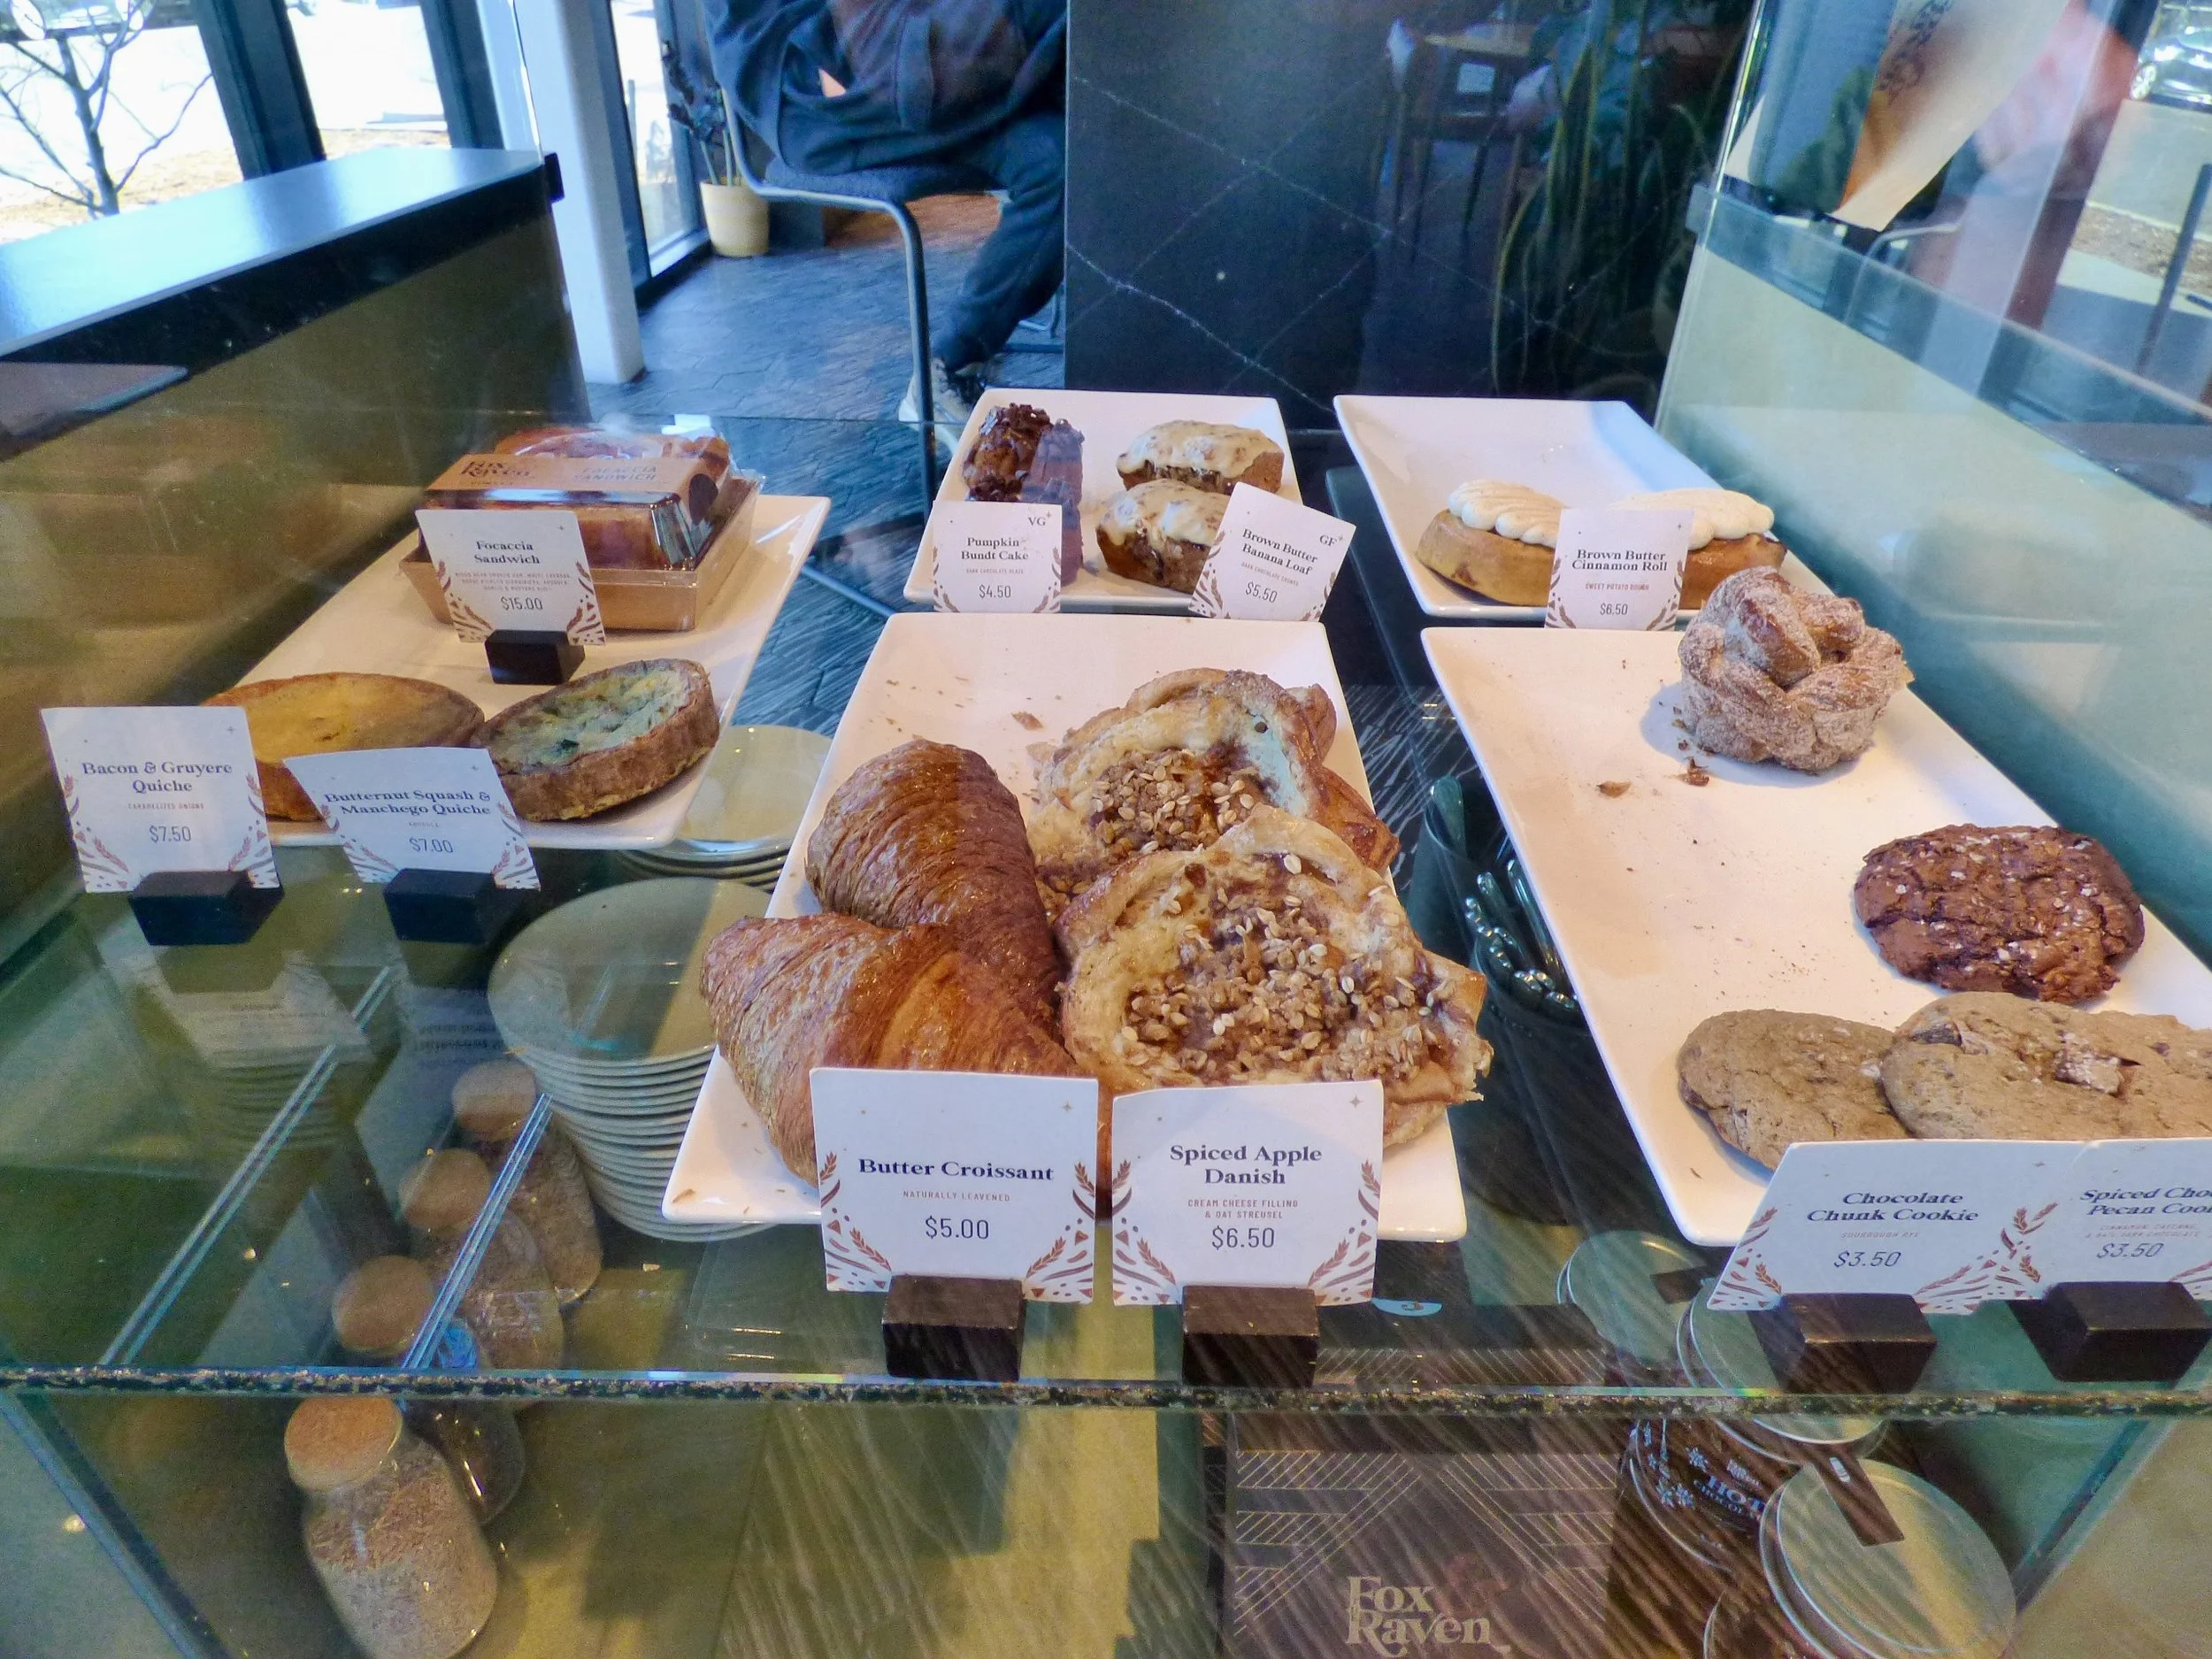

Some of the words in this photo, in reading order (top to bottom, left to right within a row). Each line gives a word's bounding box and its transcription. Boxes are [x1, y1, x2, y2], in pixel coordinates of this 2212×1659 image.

[1028, 517, 1046, 526] VG
[476, 541, 534, 550] Focaccia
[967, 537, 1019, 549] Pumpkin
[1242, 528, 1281, 550] Brown
[1283, 541, 1318, 564] Butter
[1319, 534, 1338, 547] GF
[474, 554, 541, 565] Sandwich
[961, 550, 996, 560] Bundt
[999, 550, 1029, 560] Cake
[1242, 543, 1283, 566] Banana
[1286, 558, 1314, 576] Loaf
[1577, 549, 1621, 560] Brown
[1625, 550, 1666, 561] Butter
[1572, 559, 1639, 571] Cinnamon
[1642, 562, 1668, 572] Roll
[979, 584, 1011, 599] $4.50
[1245, 581, 1278, 603] $5.50
[500, 596, 543, 611] $15.00
[1600, 603, 1628, 616] $6.50
[82, 762, 139, 774] Bacon
[143, 762, 157, 774] &
[161, 762, 233, 778] Gruyere
[133, 780, 193, 794] Quiche
[324, 791, 410, 803] Butternut
[413, 790, 474, 803] Squash
[479, 792, 491, 802] &
[340, 804, 429, 816] Manchego
[433, 803, 491, 815] Quiche
[149, 825, 192, 843] $7.50
[409, 837, 454, 854] $7.00
[1170, 1144, 1248, 1166] Spiced
[1254, 1146, 1323, 1166] Apple
[858, 1158, 935, 1176] Butter
[941, 1161, 1055, 1180] Croissant
[1204, 1168, 1286, 1185] Danish
[902, 1190, 957, 1201] NATURALLY
[961, 1192, 1010, 1202] LEAVENED
[1842, 1192, 1963, 1204] Chocolate
[2080, 1188, 2162, 1203] Spiced
[2164, 1187, 2212, 1198] Cho
[1187, 1199, 1219, 1208] CREAM
[1222, 1199, 1258, 1208] CHEESE
[2086, 1204, 2155, 1215] Pecan
[1236, 1210, 1283, 1219] STREUSEL
[1807, 1210, 1886, 1221] Chunk
[1893, 1209, 1979, 1221] Cookie
[925, 1215, 989, 1240] $5.00
[1211, 1225, 1275, 1250] $6.50
[2096, 1242, 2164, 1258] $3.50
[1833, 1250, 1902, 1268] $3.50
[1347, 1576, 1434, 1612] Fox
[1345, 1608, 1511, 1658] Raven
